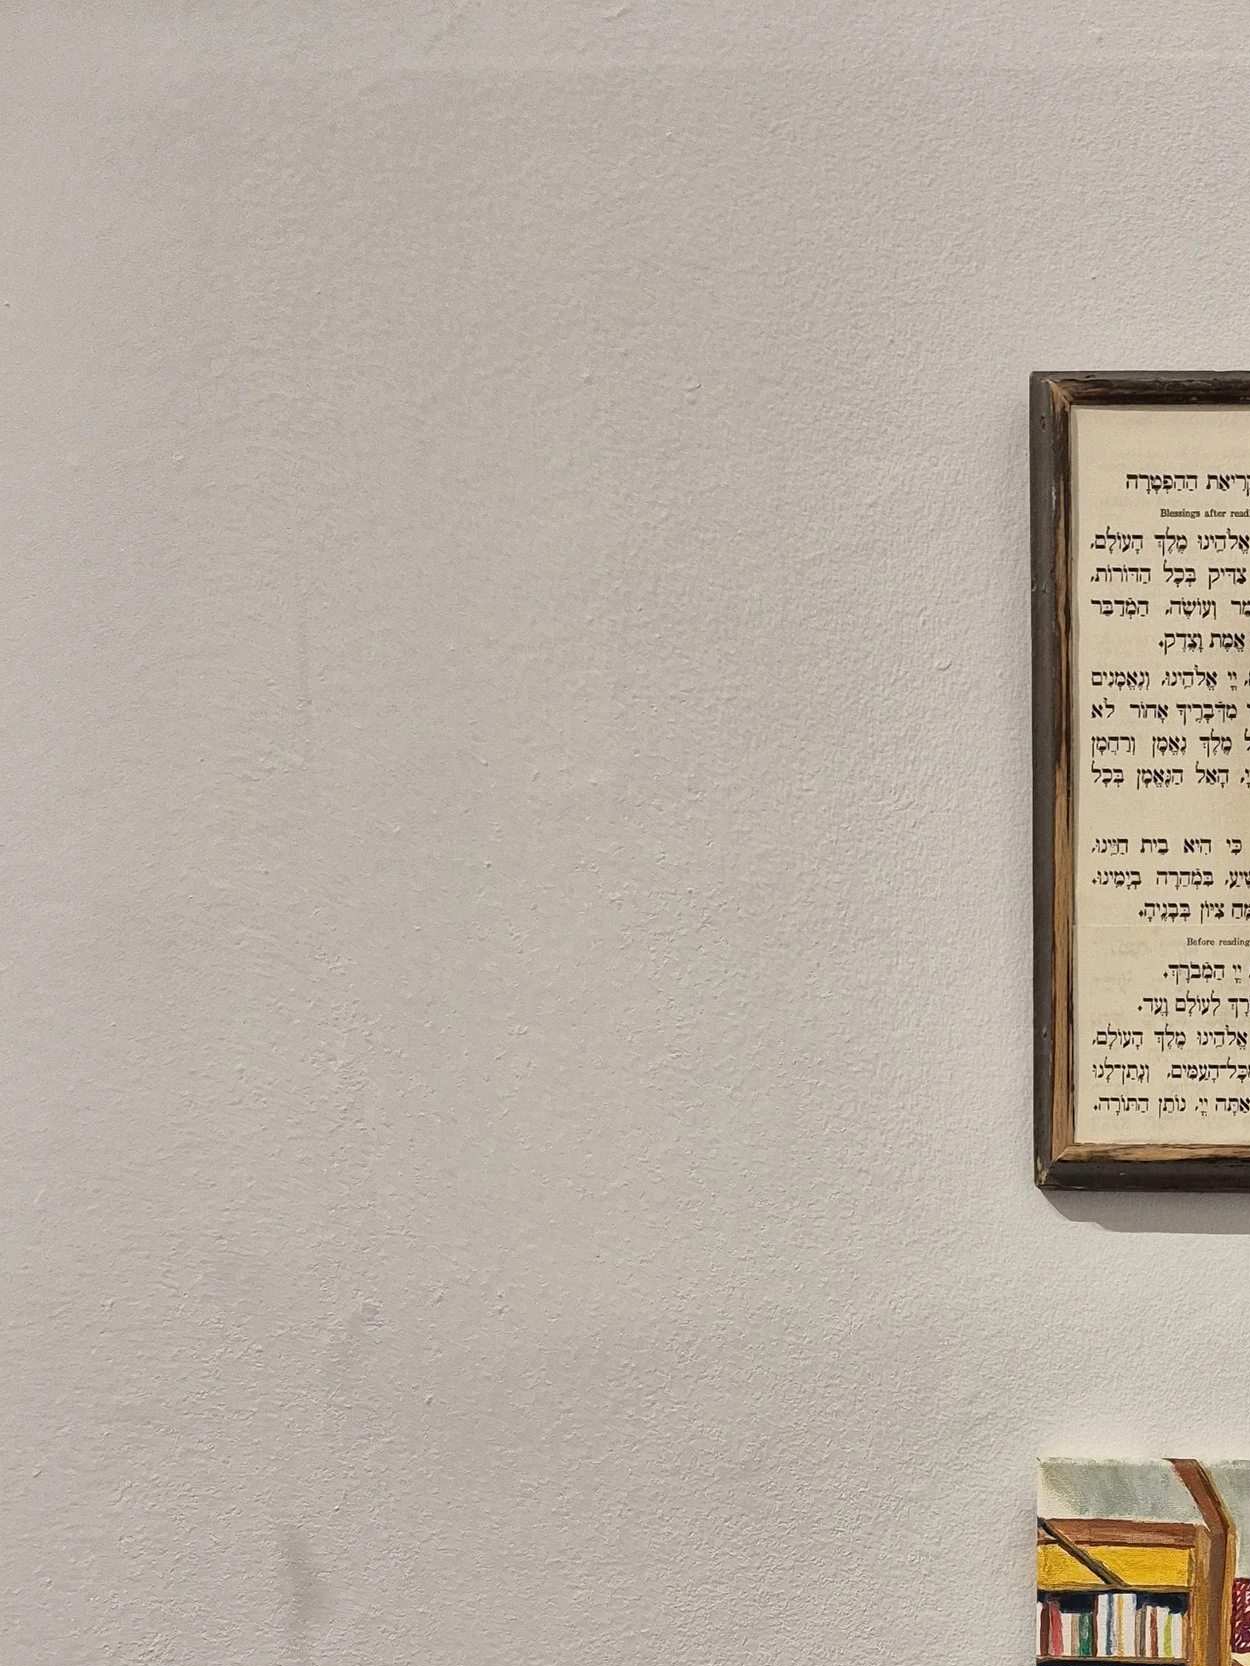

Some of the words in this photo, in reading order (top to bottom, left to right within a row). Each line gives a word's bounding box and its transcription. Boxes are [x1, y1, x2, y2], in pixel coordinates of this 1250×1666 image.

[1159, 508, 1200, 519] Blessings
[1204, 508, 1227, 517] after
[1186, 937, 1215, 946] Before
[1218, 937, 1250, 948] reading
